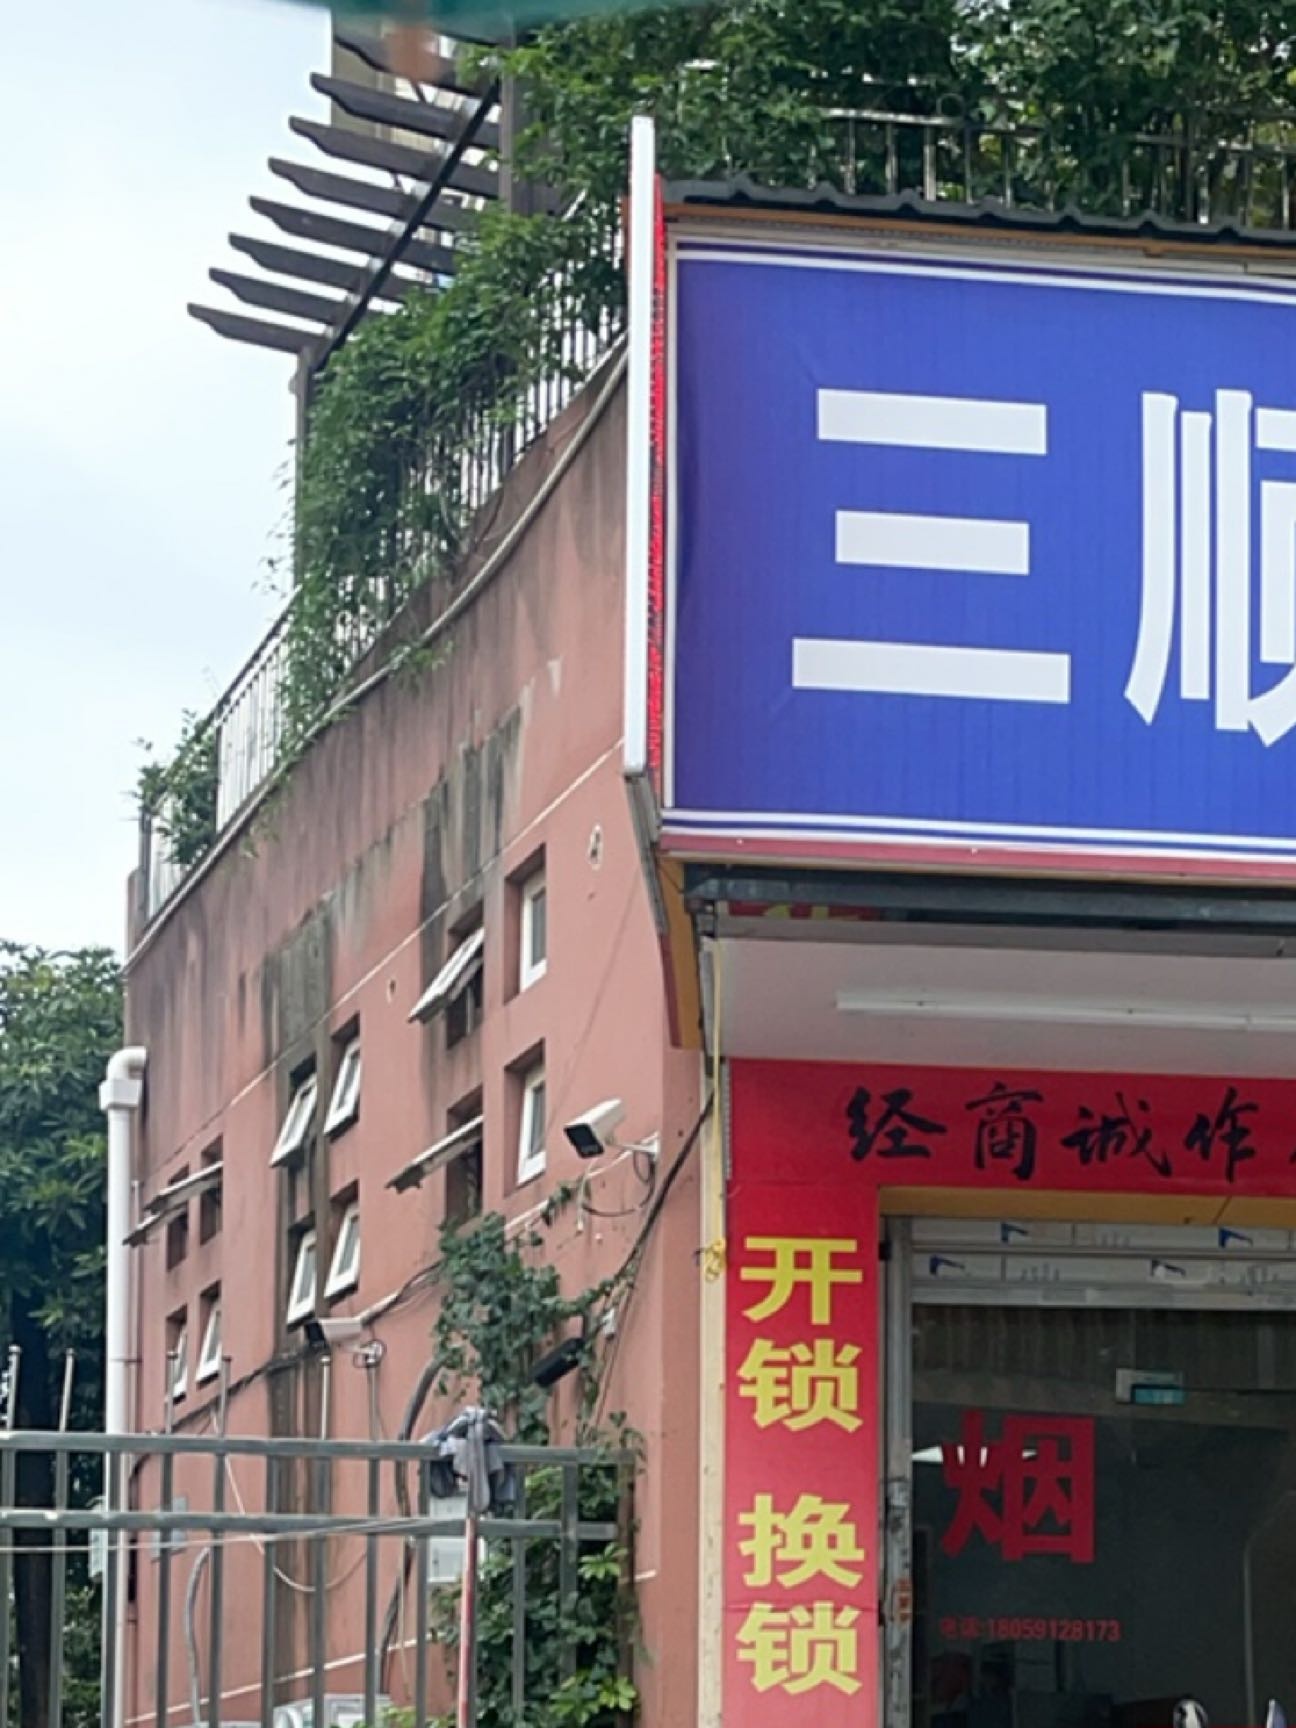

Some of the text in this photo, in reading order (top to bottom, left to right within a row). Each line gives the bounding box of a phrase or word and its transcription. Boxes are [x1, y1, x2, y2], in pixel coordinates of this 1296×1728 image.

[737, 1236, 863, 1434] 开锁
[940, 1411, 1096, 1563] 烟
[737, 1494, 864, 1695] 换锁
